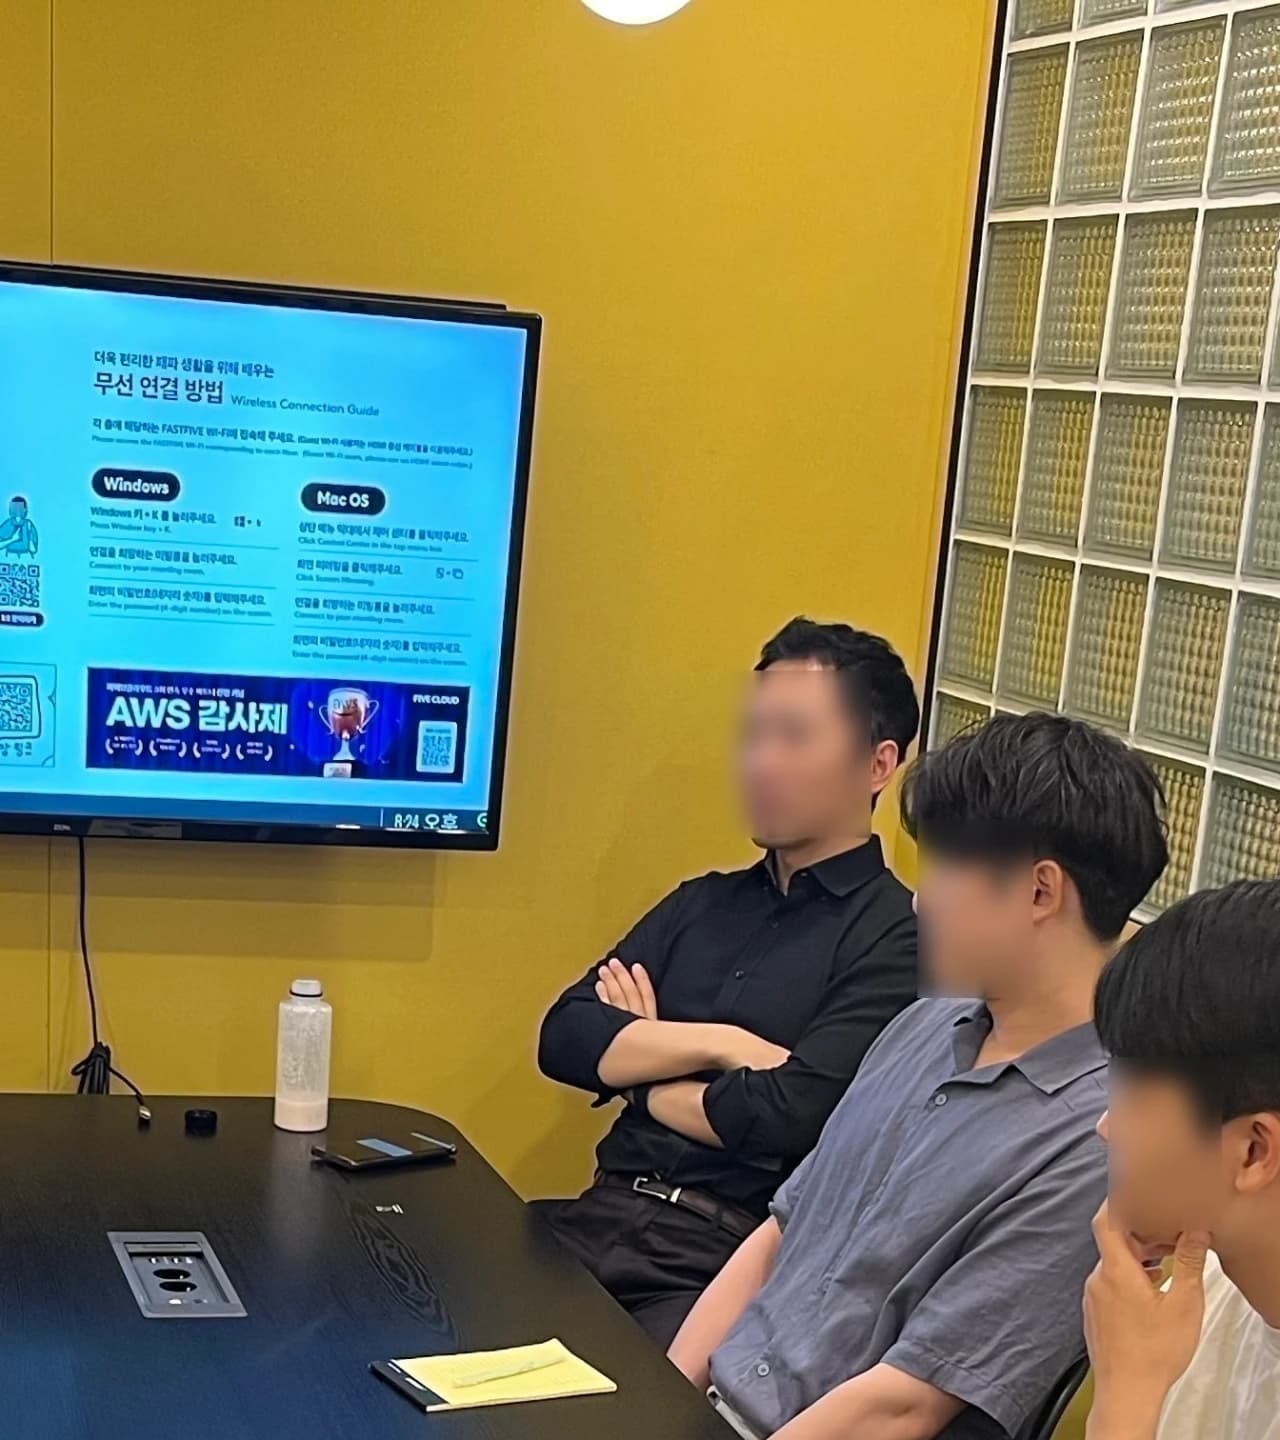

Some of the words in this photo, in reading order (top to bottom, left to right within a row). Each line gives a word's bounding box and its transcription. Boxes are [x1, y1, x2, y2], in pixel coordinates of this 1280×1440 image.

[94, 350, 116, 365] 더욱
[120, 353, 153, 368] 편리한
[181, 357, 214, 373] 생활을
[217, 360, 239, 375] 위해
[242, 362, 274, 378] 배우는
[94, 372, 133, 396] 무선
[140, 375, 179, 400] 연결
[185, 379, 223, 404] 방법
[231, 394, 276, 408] Wireless
[280, 398, 344, 413] Connection
[347, 403, 380, 416] Guide
[161, 423, 204, 437] FASTFIVE
[103, 476, 169, 494] Windows
[317, 491, 347, 506] Mac
[349, 493, 369, 507] OS
[413, 694, 430, 704] FIVE
[431, 695, 459, 705] CLOUD
[106, 696, 191, 730] AWS
[199, 700, 288, 734] 감사제
[423, 812, 458, 829] 오후
